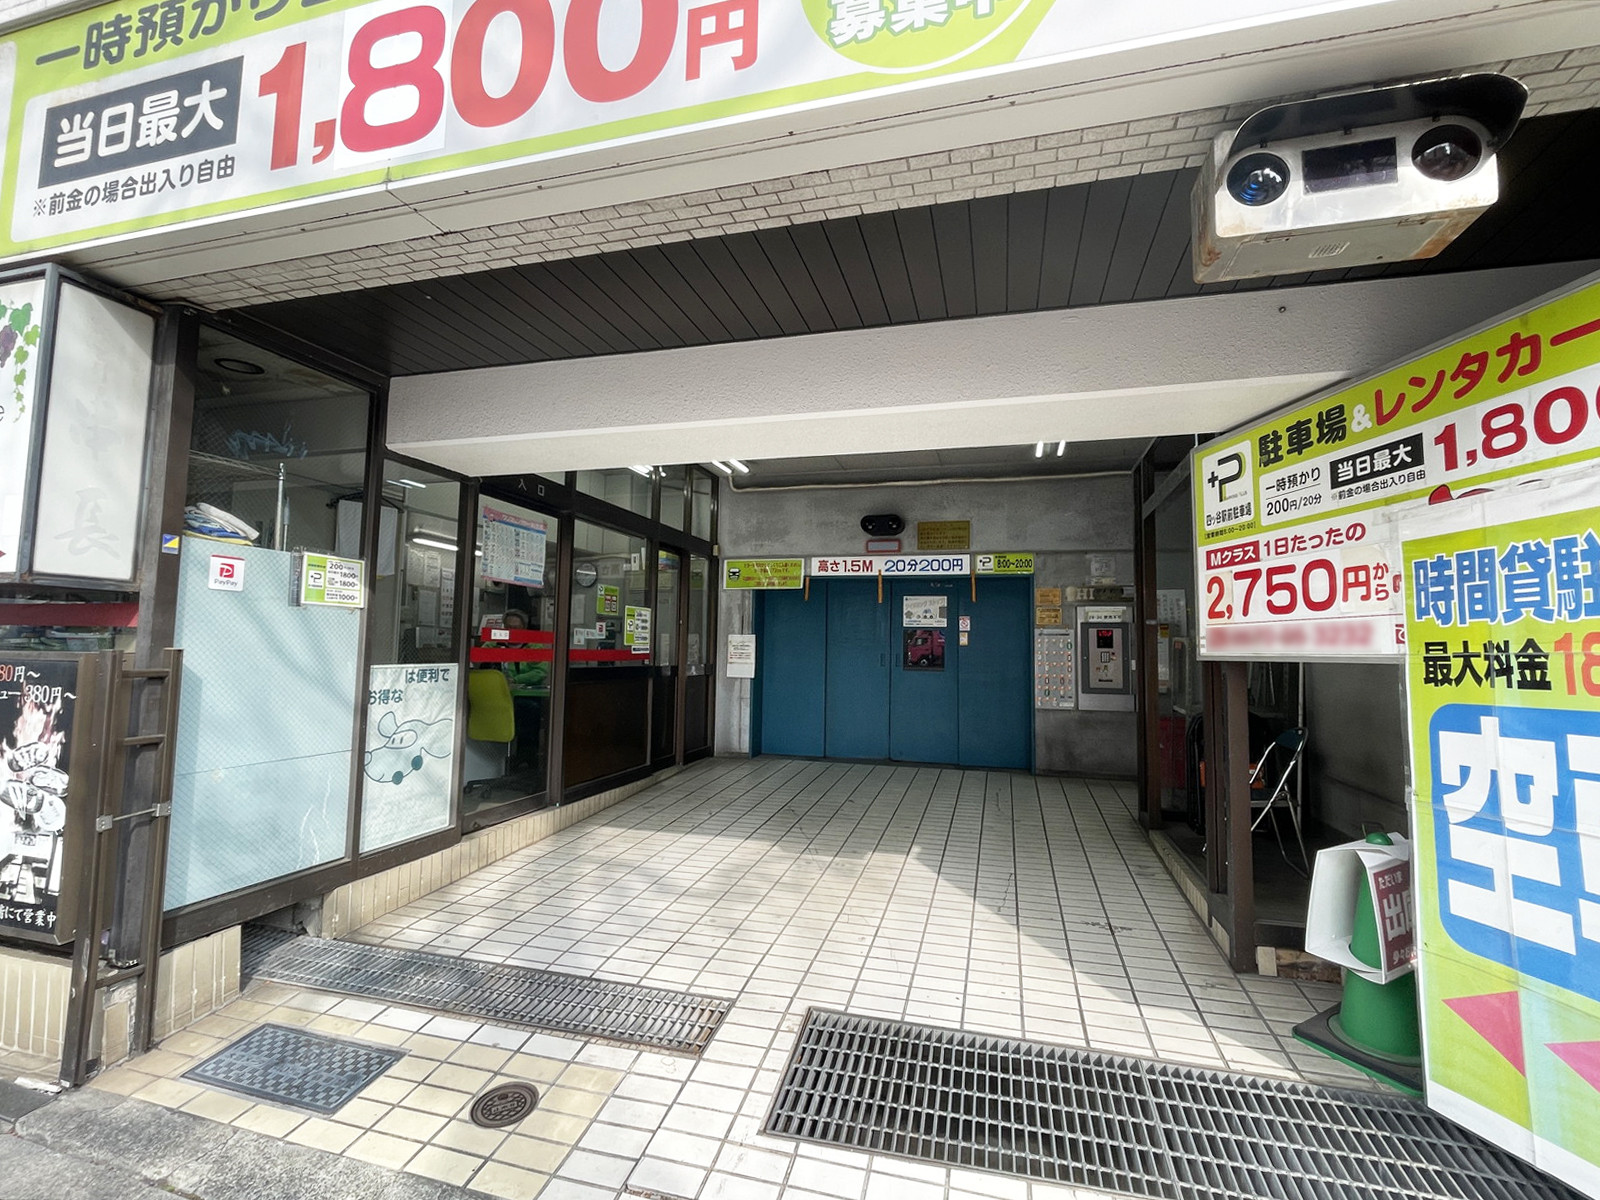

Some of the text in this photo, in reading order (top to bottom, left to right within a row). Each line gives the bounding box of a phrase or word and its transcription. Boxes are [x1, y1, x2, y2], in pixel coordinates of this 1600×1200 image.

[35, 0, 334, 69] 一時預か
[829, 0, 995, 46] 募集
[259, 0, 758, 172] 1,800円
[54, 80, 228, 168] 当日最大
[33, 155, 236, 217] ※前金の場合出入り自由
[1434, 386, 1600, 471] 1,80
[1265, 467, 1321, 491] 一時預かり
[1337, 443, 1412, 482] 当日最大
[1266, 493, 1322, 516] 200円/20分
[1210, 546, 1256, 566] Mクラス
[1264, 522, 1367, 558] 1日たったの
[818, 558, 963, 573] 高さ1.5M 20分200円
[405, 668, 450, 684] は便利で
[1423, 641, 1552, 691] 最大料金
